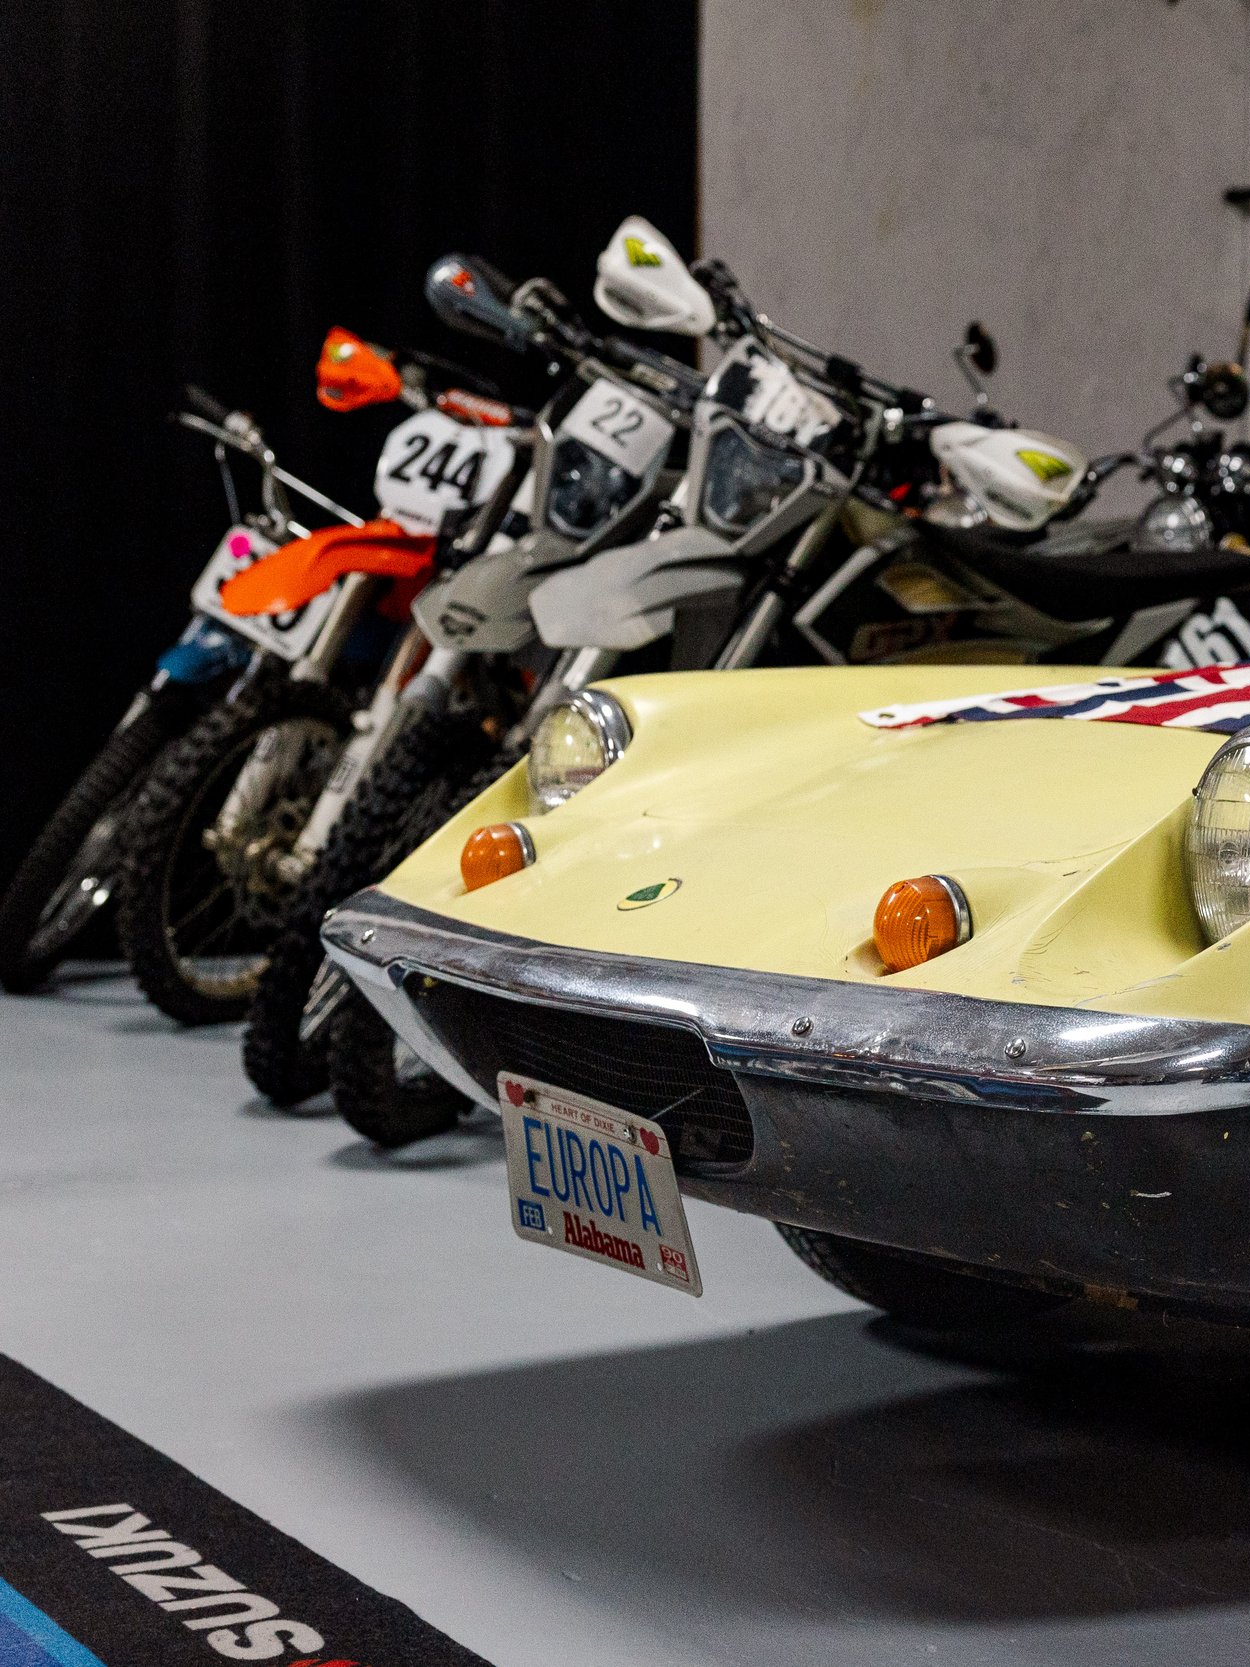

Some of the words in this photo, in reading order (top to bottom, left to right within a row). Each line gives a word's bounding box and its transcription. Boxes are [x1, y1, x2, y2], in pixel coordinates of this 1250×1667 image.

[590, 398, 645, 450] 22
[388, 433, 488, 501] 244
[551, 1103, 579, 1120] HEART
[580, 1112, 592, 1123] OF
[593, 1117, 615, 1133] DIXIE
[523, 1115, 662, 1237] EUROPA
[522, 1206, 543, 1229] FEB
[562, 1211, 646, 1270] Alabama
[661, 1246, 683, 1264] 90
[39, 1502, 326, 1662] SUZUKI
